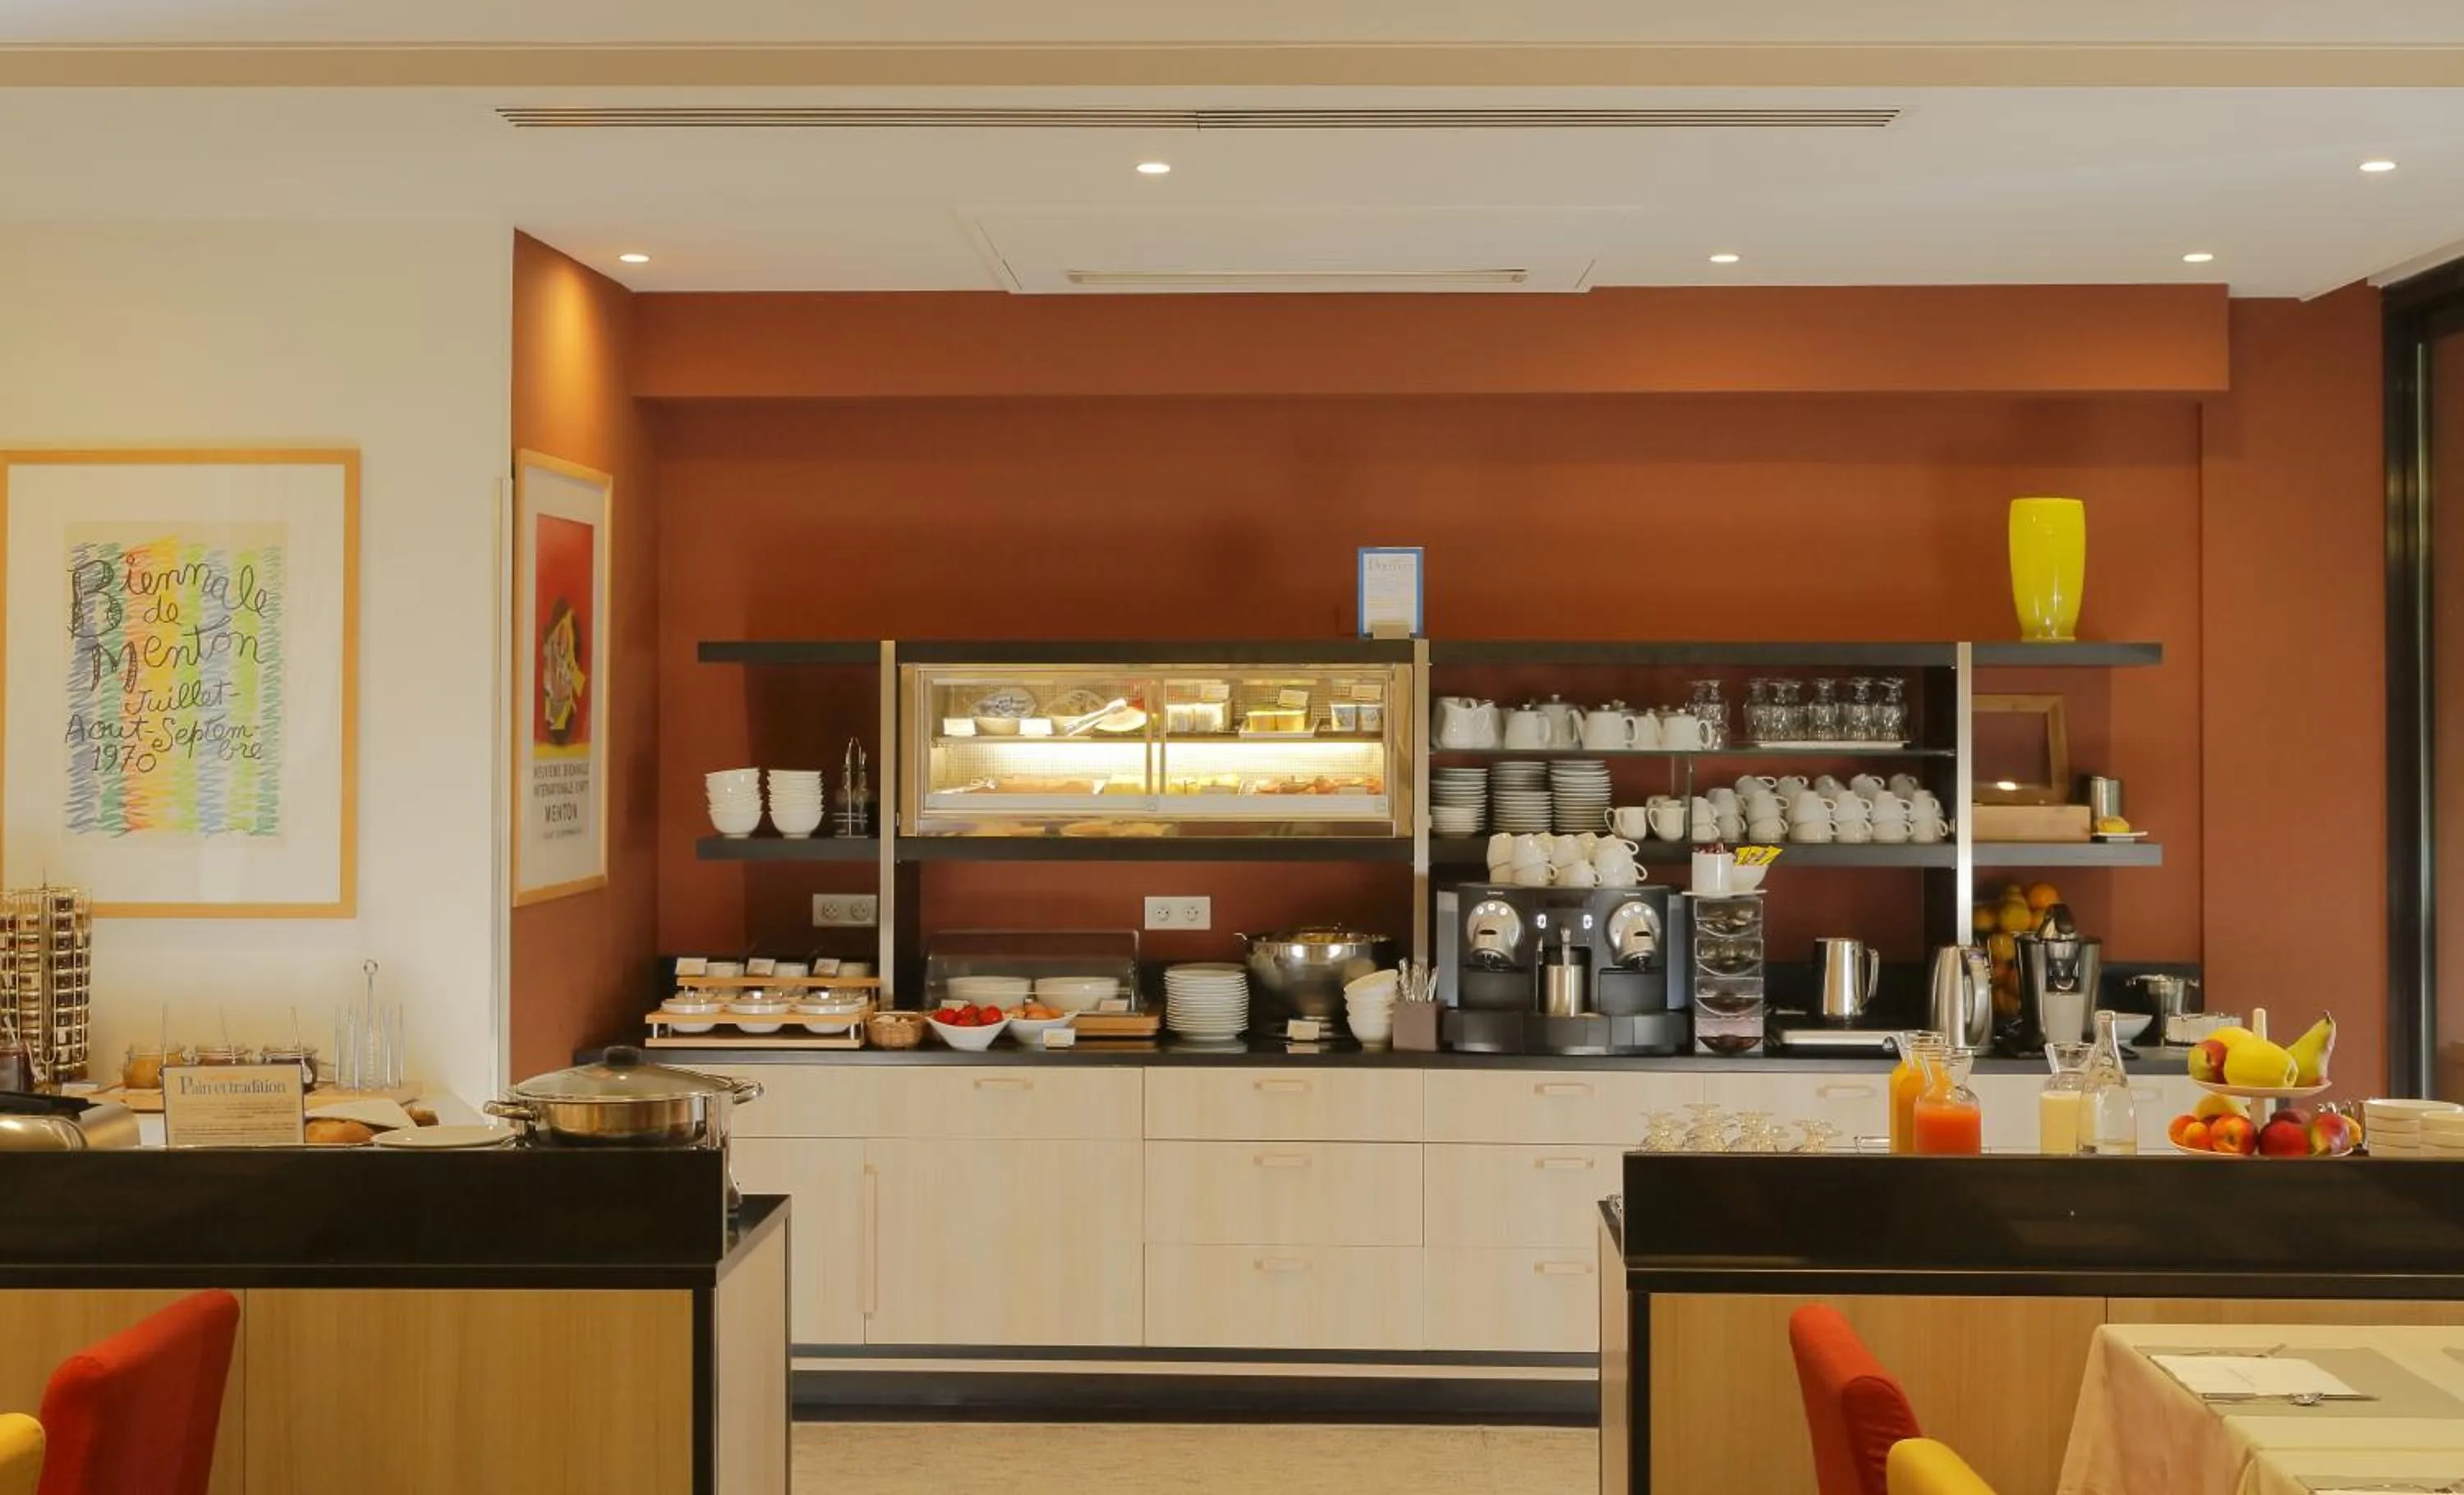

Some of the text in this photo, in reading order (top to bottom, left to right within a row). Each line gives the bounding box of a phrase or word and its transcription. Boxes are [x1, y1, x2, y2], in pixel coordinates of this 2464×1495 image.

[67, 554, 268, 639] Biennale
[144, 597, 182, 627] de
[83, 614, 267, 694] Menton
[91, 745, 157, 773] 1970
[179, 1075, 211, 1096] Pain
[228, 1079, 287, 1094] tradition
